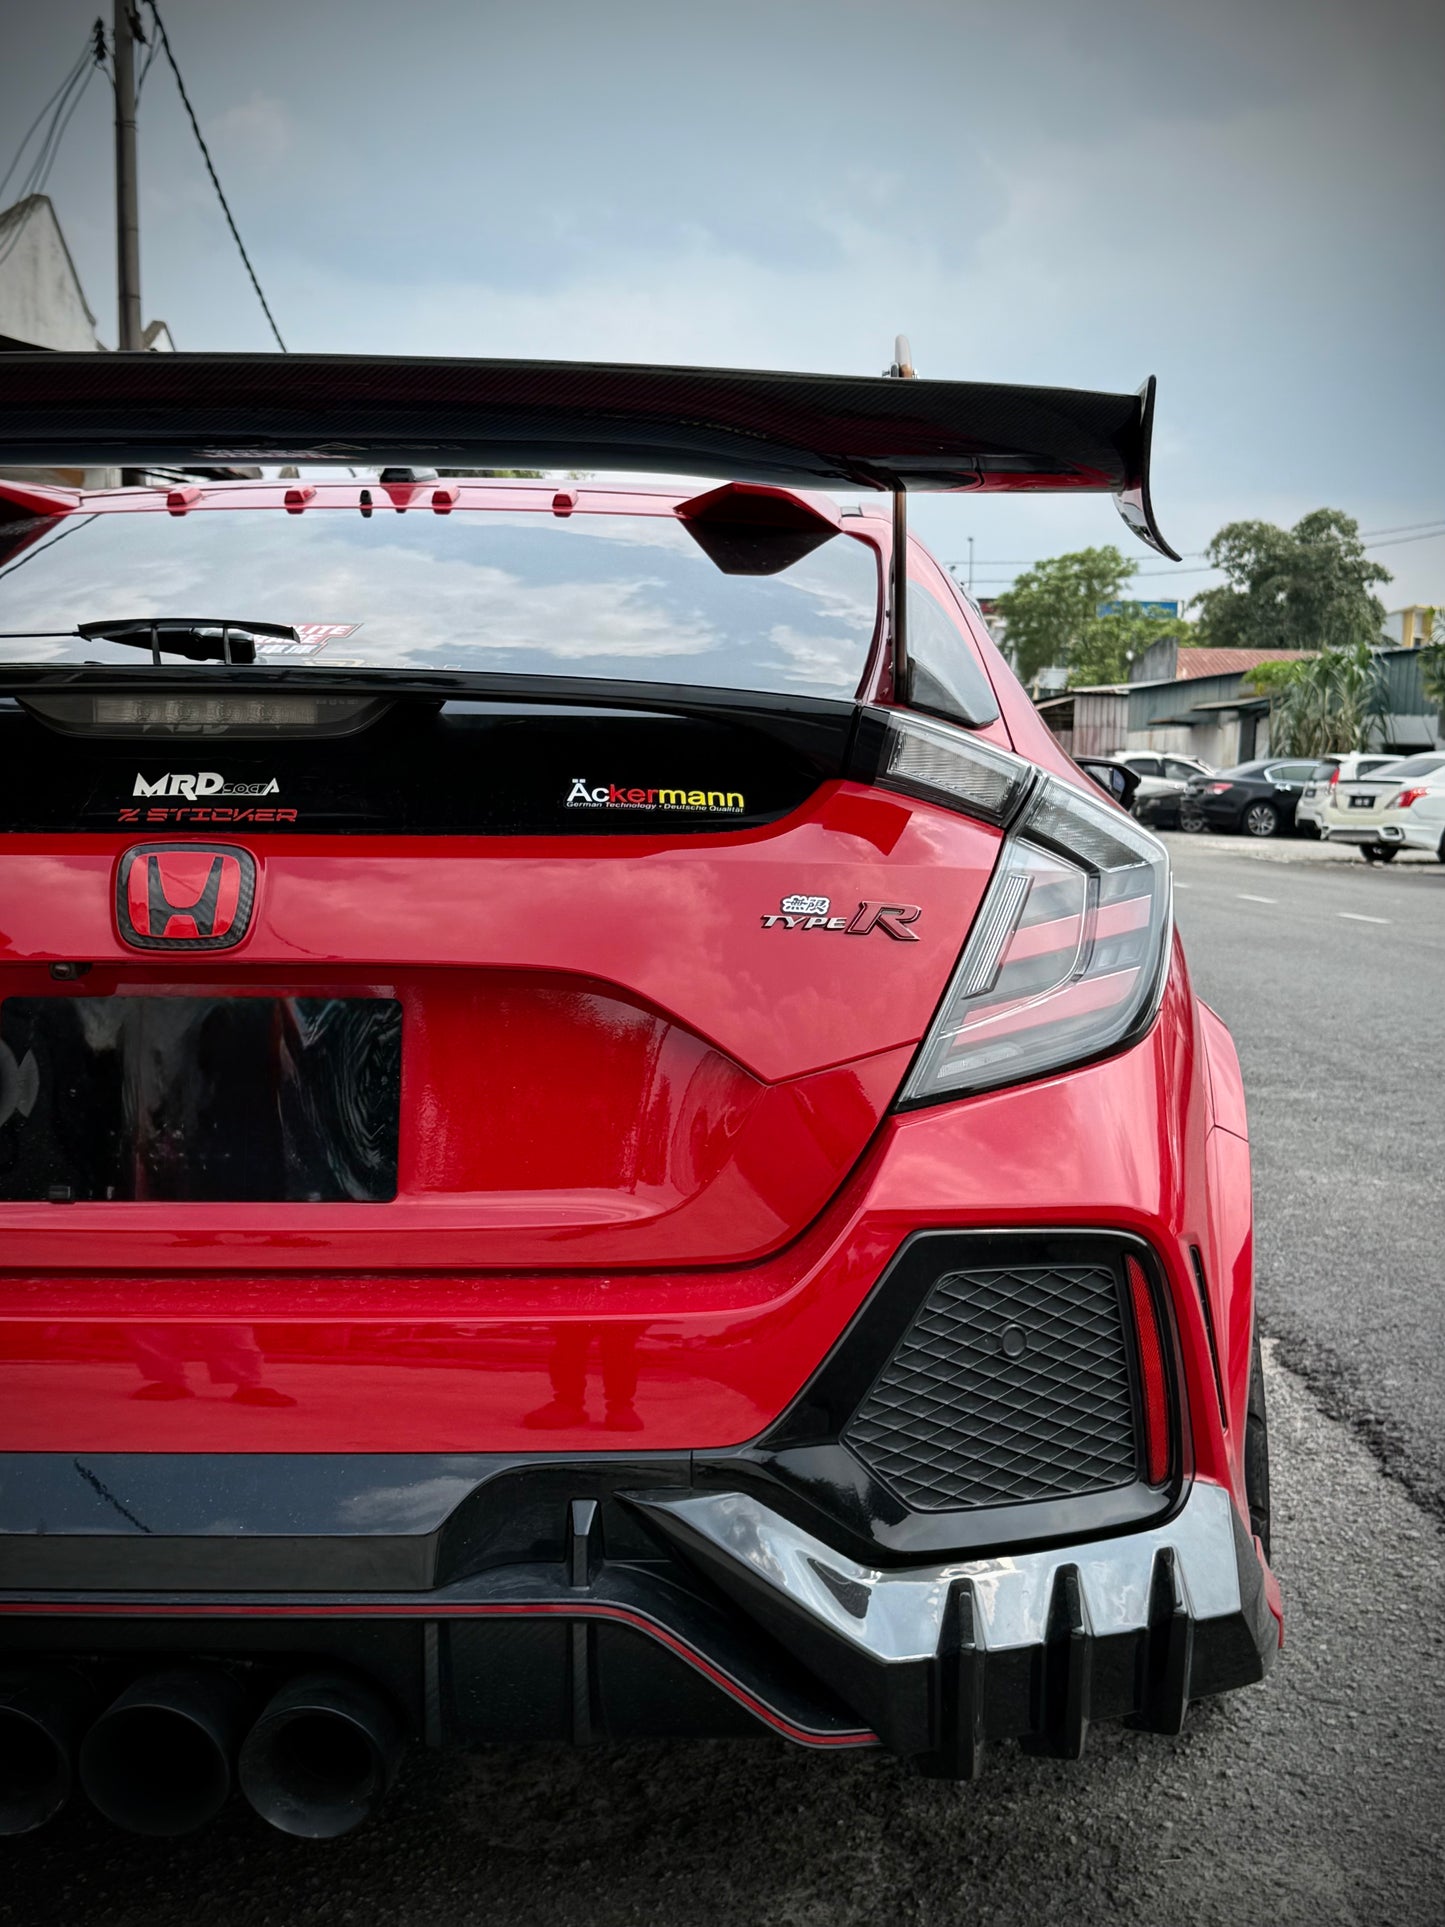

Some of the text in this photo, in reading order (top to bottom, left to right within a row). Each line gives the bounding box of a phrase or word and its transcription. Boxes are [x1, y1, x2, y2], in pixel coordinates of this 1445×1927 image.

[566, 778, 745, 808] Äckermann
[146, 808, 298, 823] STICKER
[605, 802, 657, 811] Technology
[664, 803, 707, 811] Deutsche
[761, 901, 922, 942] TYPE R
